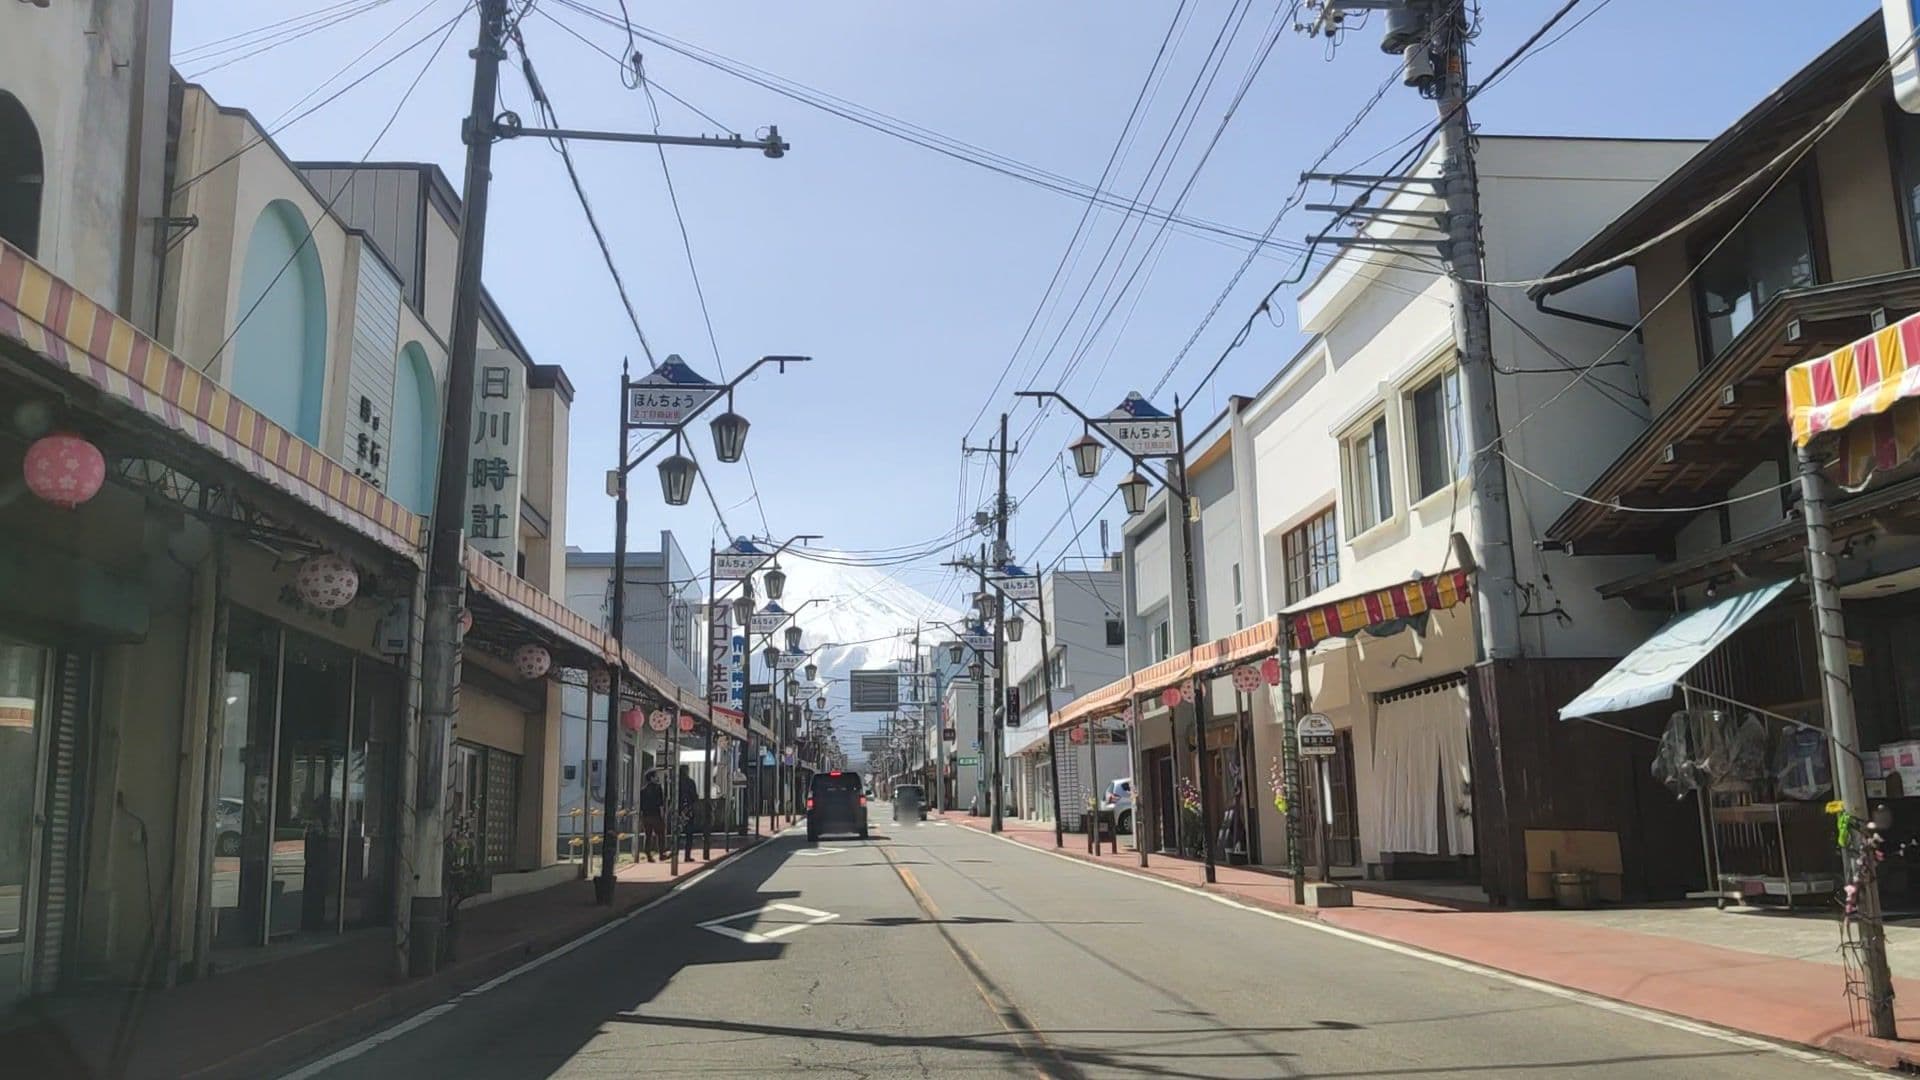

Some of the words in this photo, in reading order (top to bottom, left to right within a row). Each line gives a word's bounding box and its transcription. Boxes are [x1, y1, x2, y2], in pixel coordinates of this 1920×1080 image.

[634, 393, 694, 408] ほんちょう
[1118, 426, 1171, 439] ほんちょう
[718, 559, 754, 568] ほんちょう
